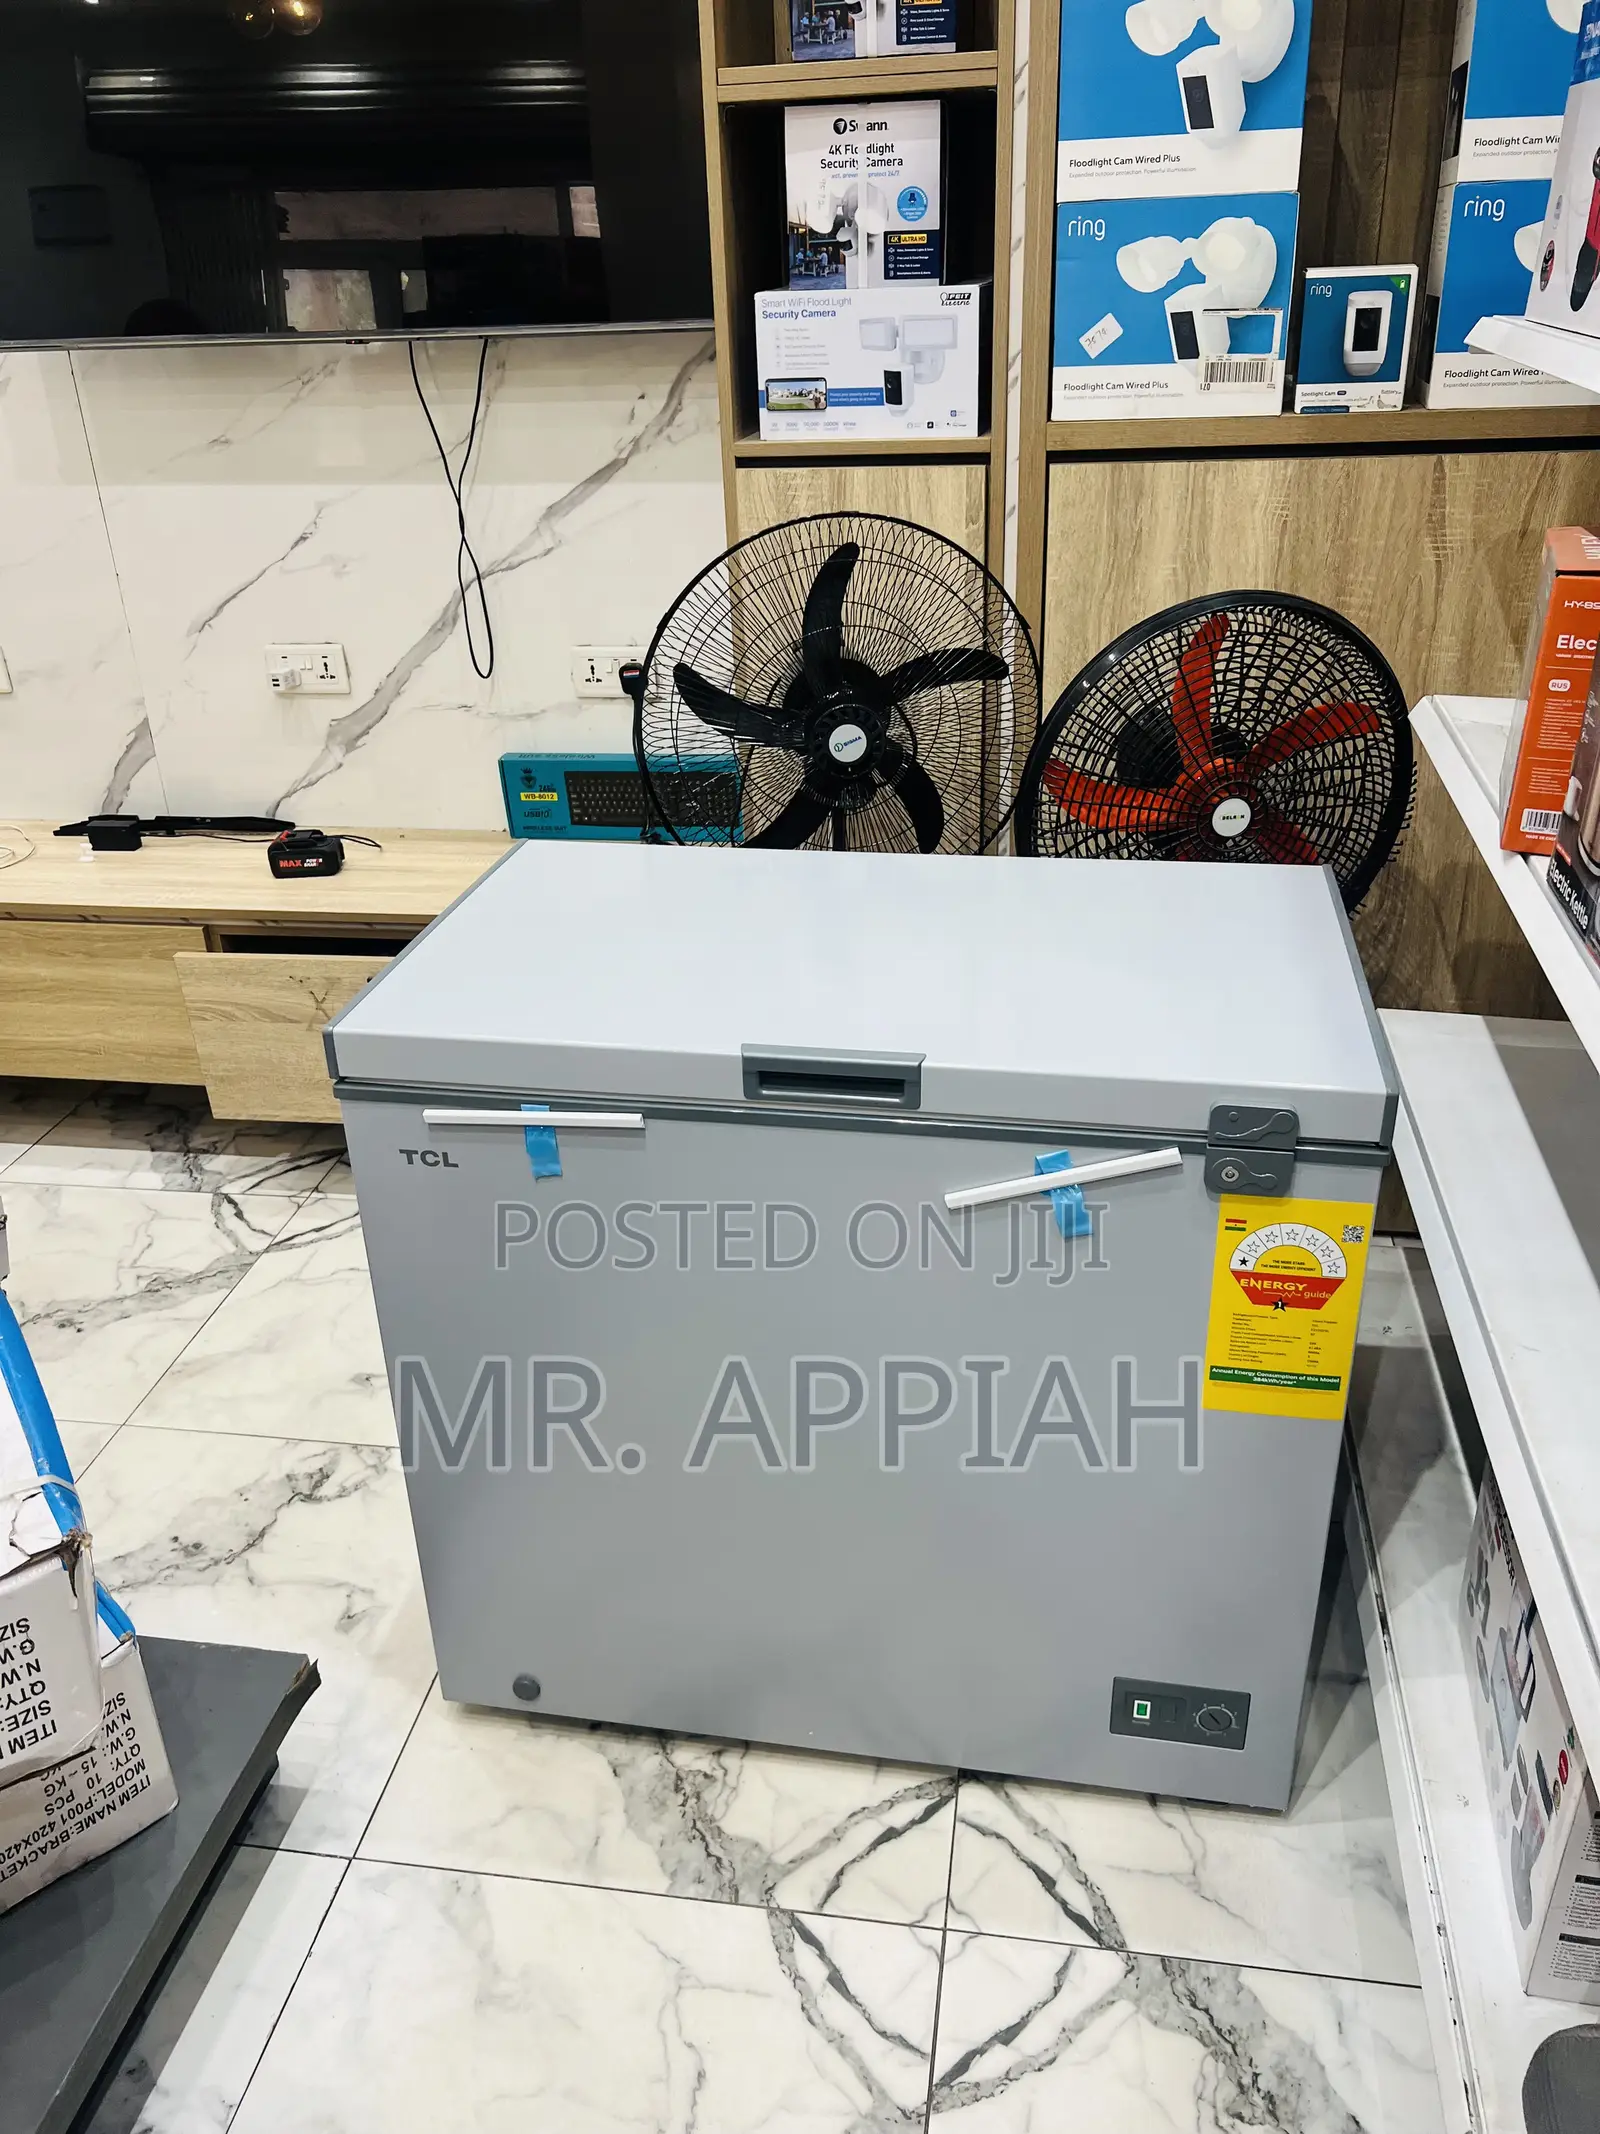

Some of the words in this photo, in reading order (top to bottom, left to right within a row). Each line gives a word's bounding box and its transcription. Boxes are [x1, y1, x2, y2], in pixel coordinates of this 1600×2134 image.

[848, 120, 888, 132] Sann
[828, 144, 842, 156] 4K
[844, 143, 894, 156] Flodlight
[1474, 136, 1520, 148] Floodlight
[1522, 136, 1543, 145] Cam
[1069, 158, 1112, 168] Floodlight
[1114, 156, 1133, 166] Cam
[1135, 154, 1161, 164] Wired
[1163, 154, 1181, 162] Plus
[1464, 195, 1506, 222] ring
[1068, 216, 1106, 241] ring
[1310, 283, 1332, 298] ring
[761, 298, 786, 308] Smart
[788, 297, 806, 307] WiFi
[807, 297, 830, 306] Flood
[832, 296, 852, 308] Light
[762, 310, 800, 320] Security
[801, 309, 836, 318] Camera
[1444, 370, 1489, 380] Floodlight
[1490, 368, 1510, 377] Cam
[1064, 383, 1104, 392] Floodlight
[1106, 382, 1124, 390] Cam
[1126, 382, 1150, 390] Wired
[1152, 381, 1169, 389] Plus
[1551, 682, 1568, 690] RUS
[280, 860, 302, 868] MAX
[1548, 860, 1572, 902] Electric
[1570, 890, 1588, 930] Kettle
[399, 1148, 459, 1168] TCL
[1240, 1277, 1308, 1291] ENERGY
[1304, 1291, 1332, 1299] guide
[1257, 1371, 1298, 1380] Consumption
[102, 1692, 126, 1719] SIZ
[8, 1719, 58, 1754] ITEM
[81, 1756, 98, 1774] 15
[110, 1743, 140, 1772] QTY:
[44, 1775, 67, 1798] KG
[86, 1772, 102, 1790] 10
[60, 1758, 146, 1826] MODEL:P001
[118, 1774, 151, 1807] ITEM
[44, 1789, 76, 1816] PCS
